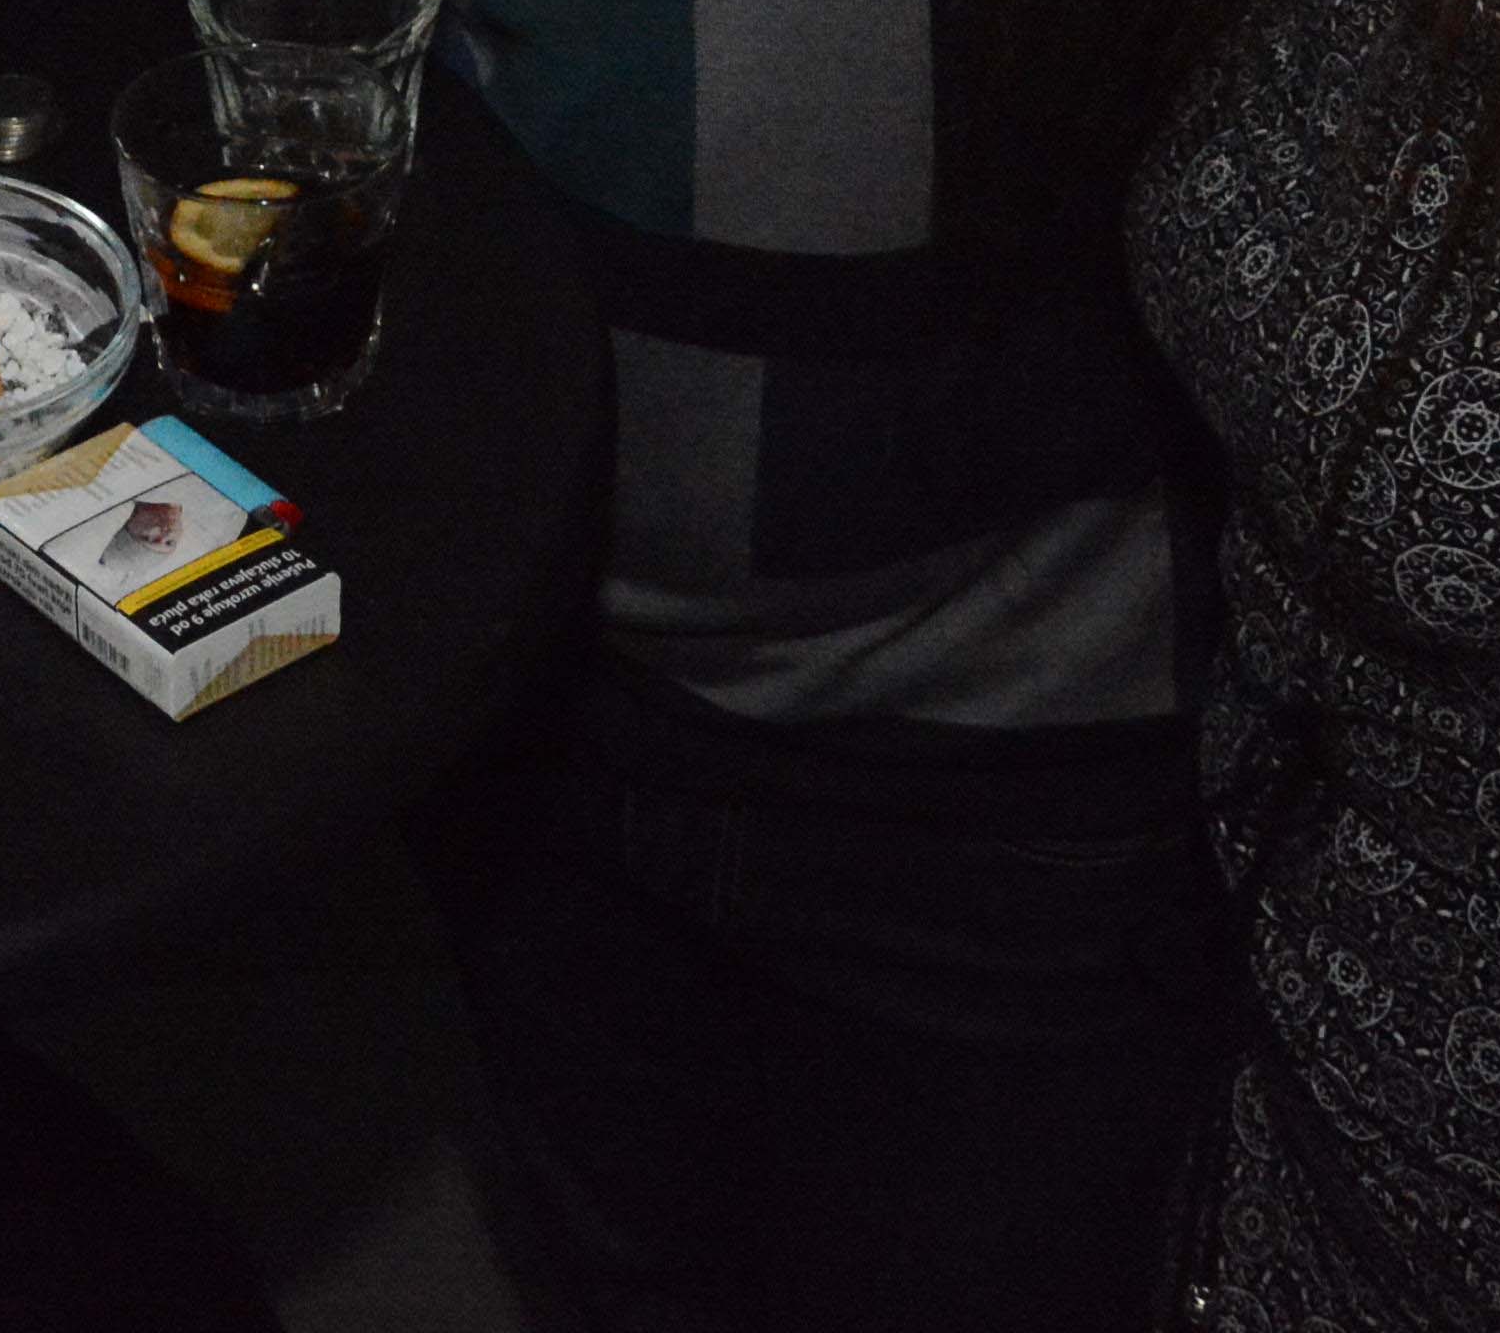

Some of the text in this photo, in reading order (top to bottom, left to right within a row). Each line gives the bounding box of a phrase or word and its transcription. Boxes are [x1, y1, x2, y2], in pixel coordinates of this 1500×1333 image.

[148, 549, 302, 627] 10 slučajeva raka pluća
[169, 558, 317, 637] Pušenje uzrokuje 9 od
